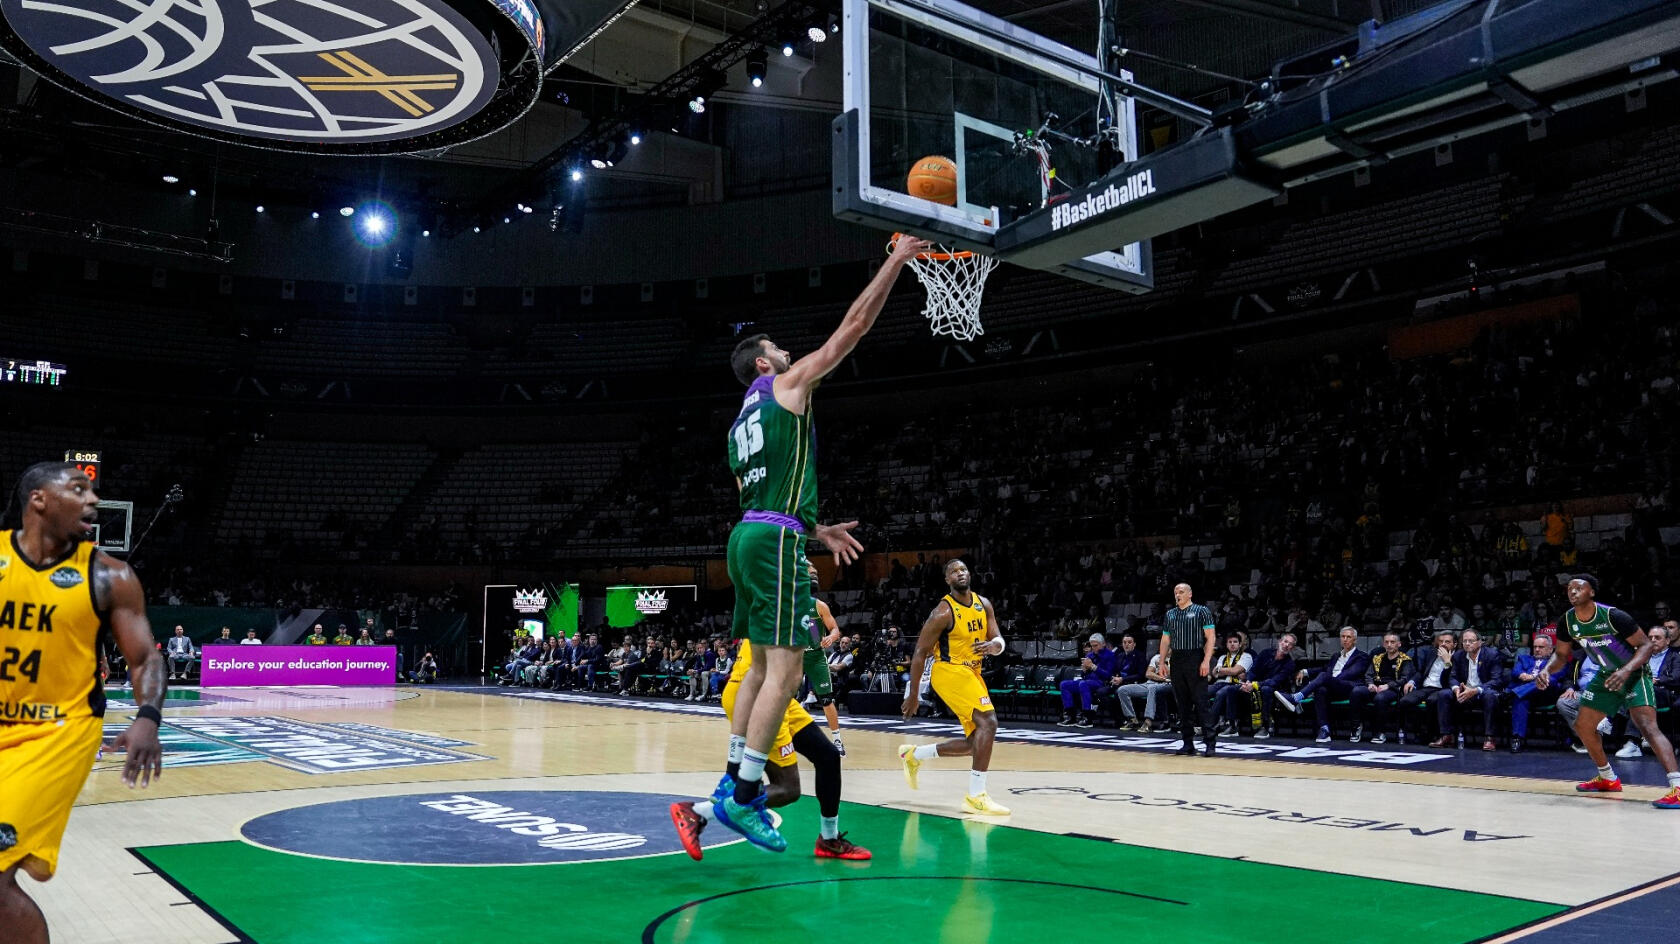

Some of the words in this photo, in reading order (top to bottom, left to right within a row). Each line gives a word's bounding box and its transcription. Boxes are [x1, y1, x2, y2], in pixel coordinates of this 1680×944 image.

[1051, 169, 1156, 230] #BasketballCL
[75, 452, 98, 462] 6:02
[0, 600, 58, 633] AEK
[967, 618, 984, 633] AEK
[0, 646, 42, 684] 24
[208, 658, 255, 672] Explore
[258, 661, 285, 672] your
[288, 658, 343, 669] education
[344, 659, 390, 672] journey.
[418, 794, 589, 836] SUNEL
[1086, 792, 1535, 842] AMERESCO
